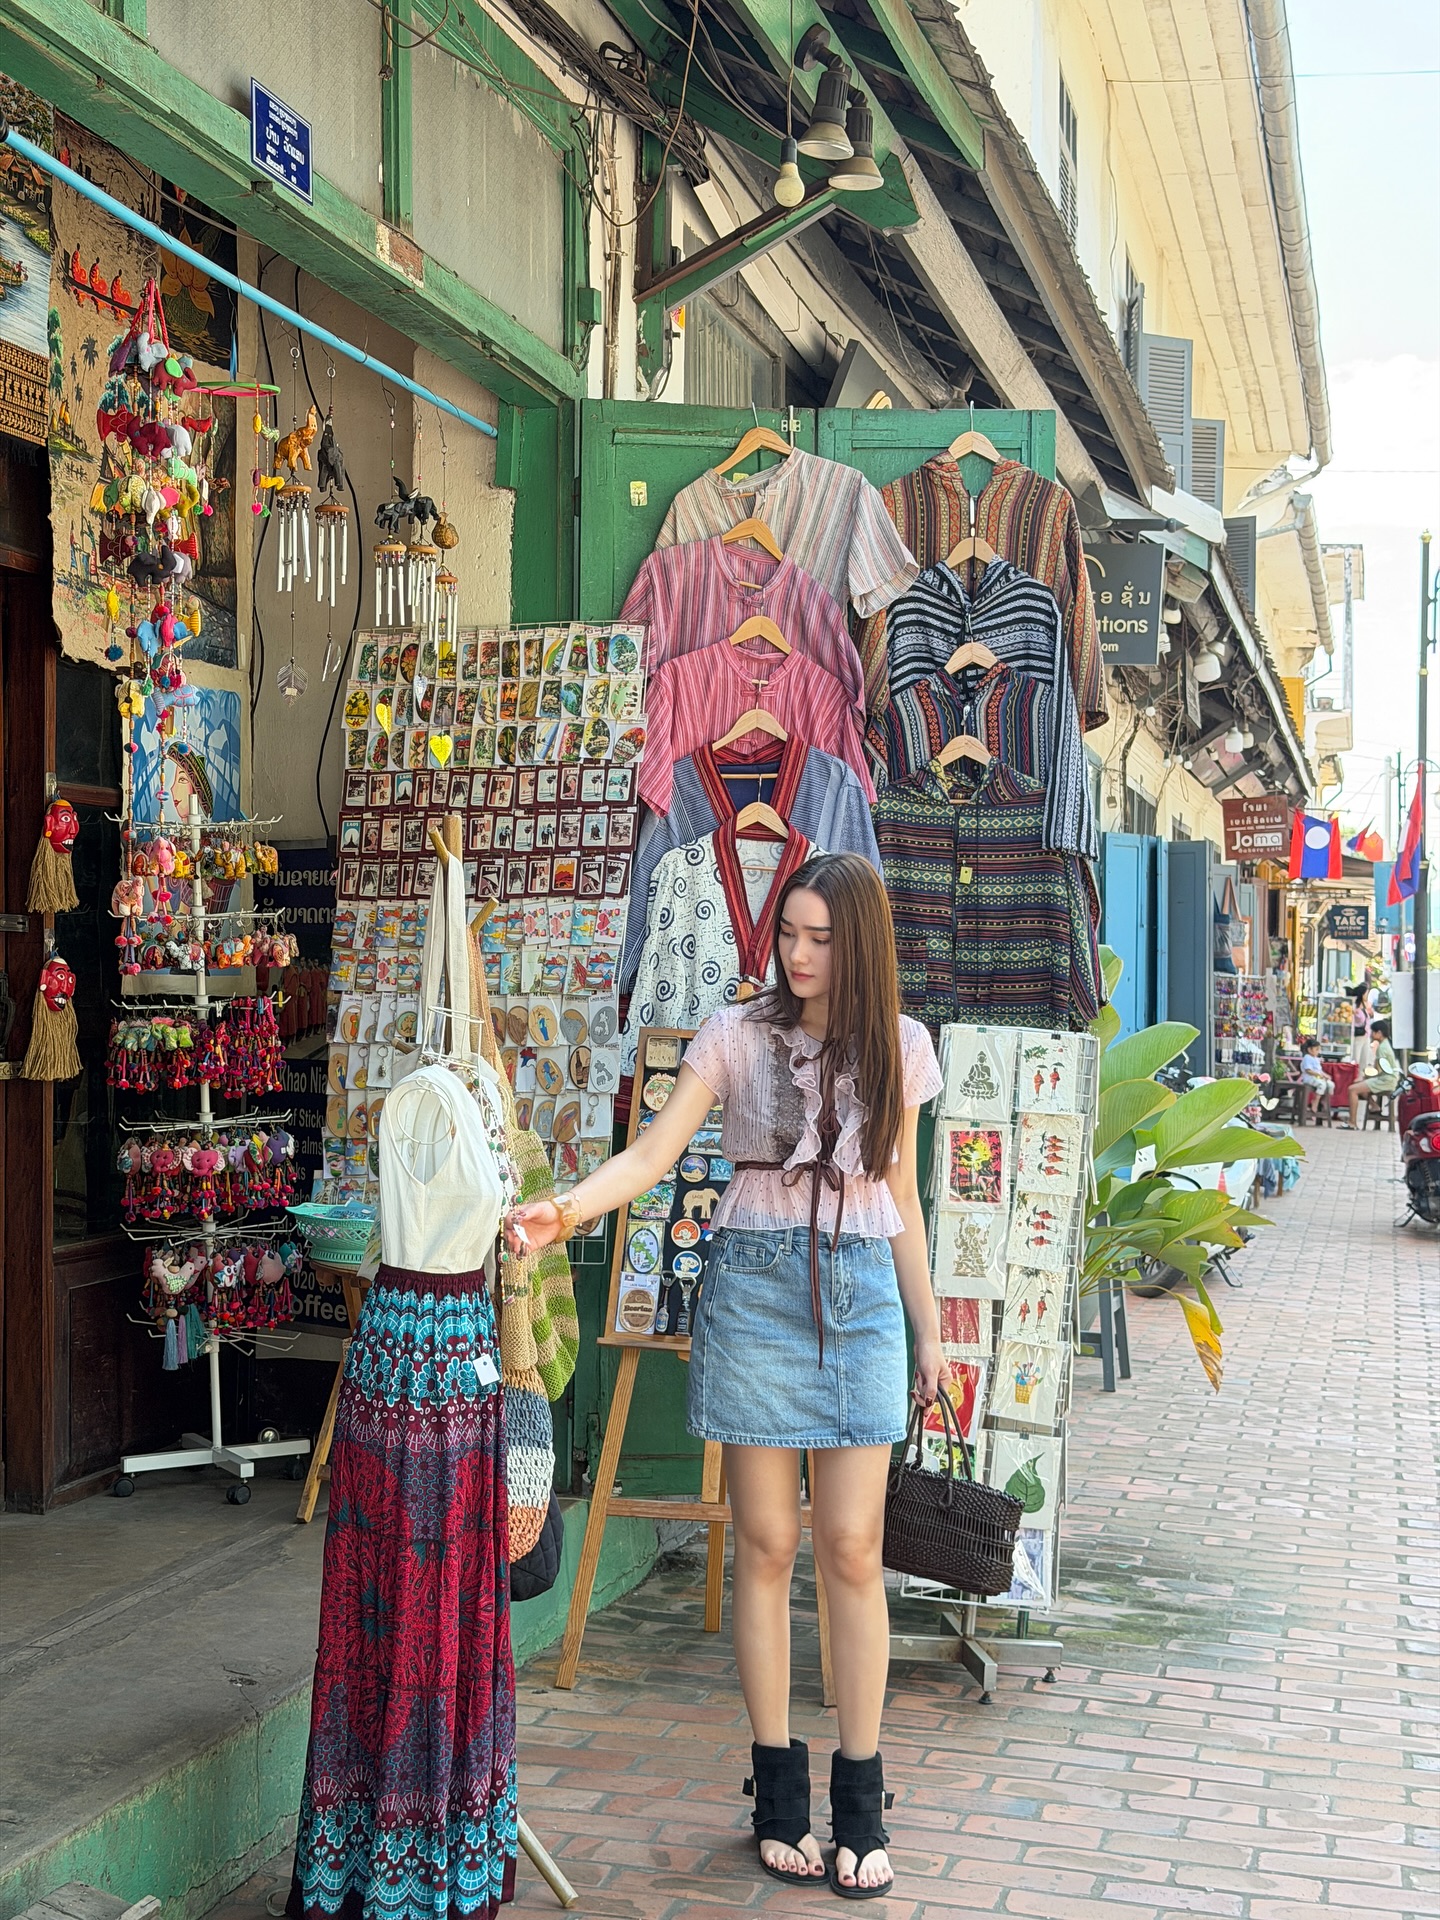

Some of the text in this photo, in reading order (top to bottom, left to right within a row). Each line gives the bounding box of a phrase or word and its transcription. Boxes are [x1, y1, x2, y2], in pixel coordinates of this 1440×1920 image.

[1101, 643, 1119, 652] om
[1231, 830, 1280, 851] Joma
[1333, 915, 1366, 926] TAEC
[279, 1065, 328, 1094] Khao Nia
[293, 1270, 315, 1291] 020
[291, 1293, 348, 1323] offee
[623, 1304, 653, 1313] Beerlao
